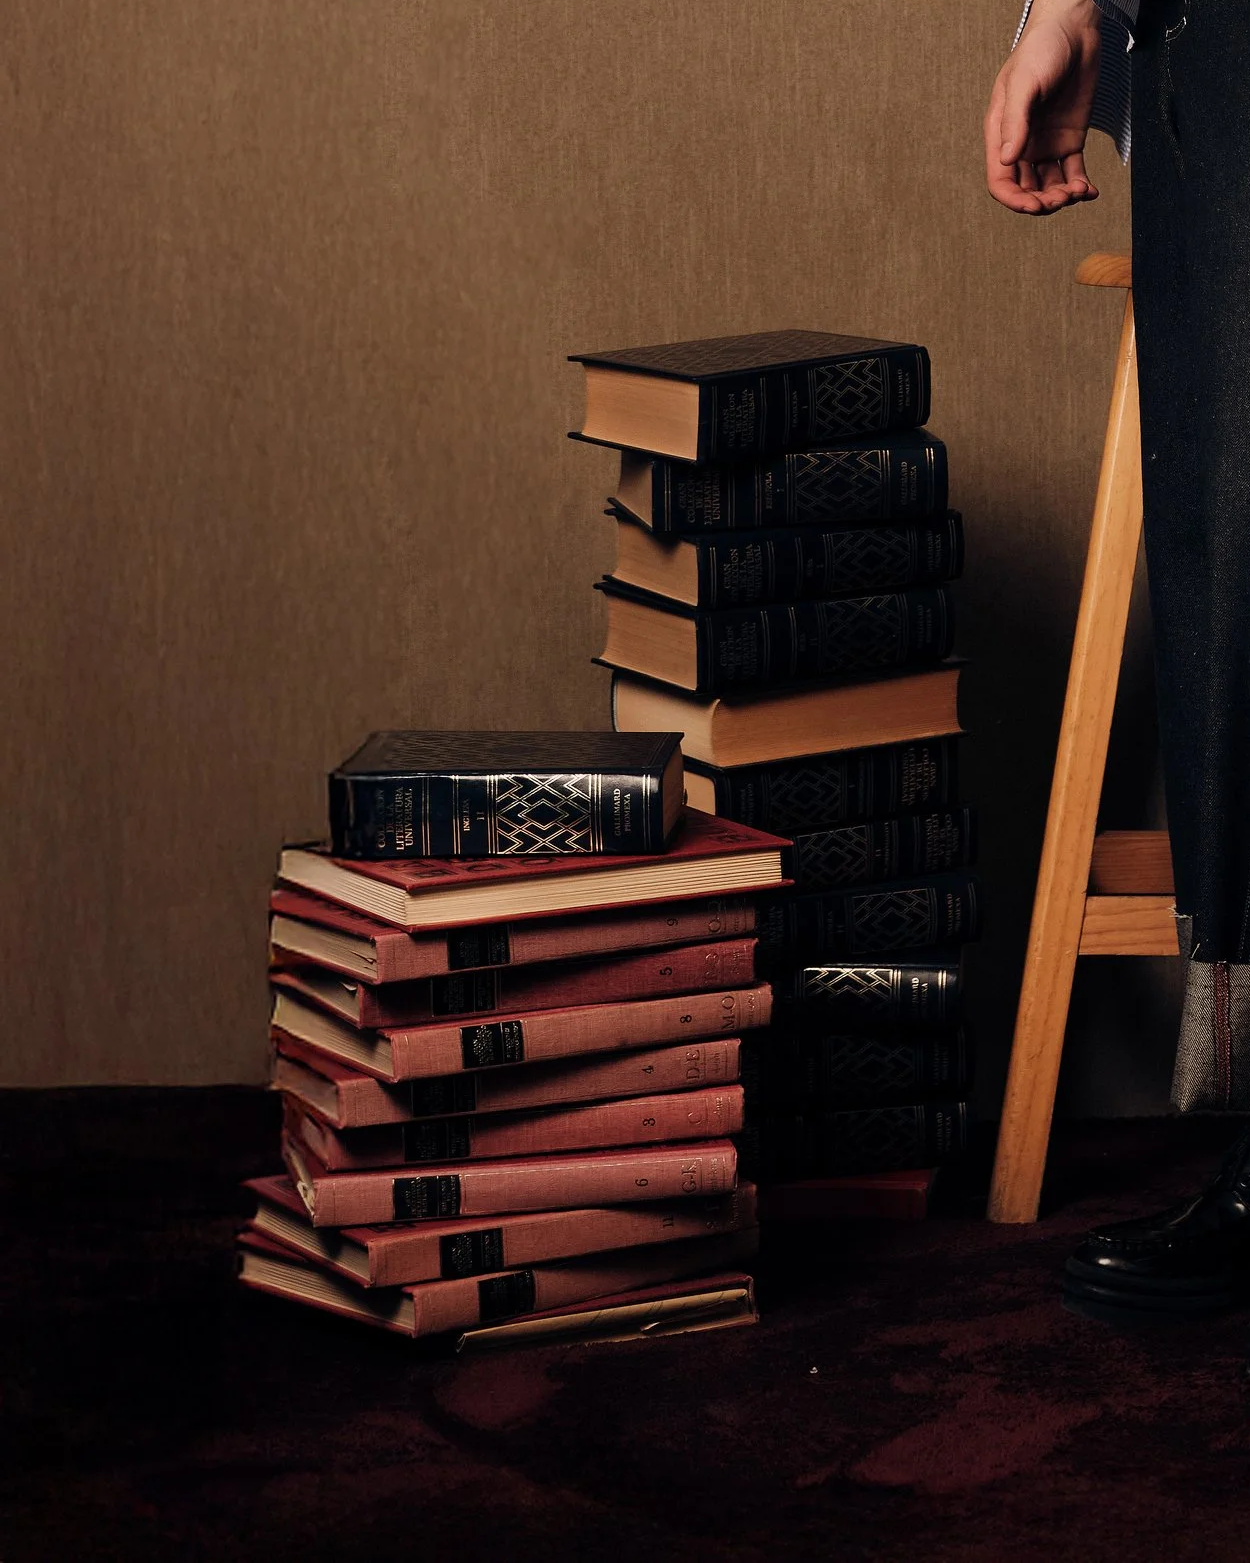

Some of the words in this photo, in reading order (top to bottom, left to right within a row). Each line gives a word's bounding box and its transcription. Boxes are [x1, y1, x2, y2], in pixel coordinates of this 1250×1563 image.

[385, 803, 394, 816] LA
[462, 797, 471, 831] INGLESA
[612, 788, 621, 836] GALLIMARD
[622, 793, 631, 832] PROMEXA
[394, 786, 405, 851] LITERATURA
[404, 788, 414, 847] UNIVERSAL
[666, 918, 678, 927] 9
[680, 1015, 692, 1024] 8
[641, 1065, 654, 1074] 4
[642, 1118, 656, 1127] 3
[635, 1179, 648, 1188] 6
